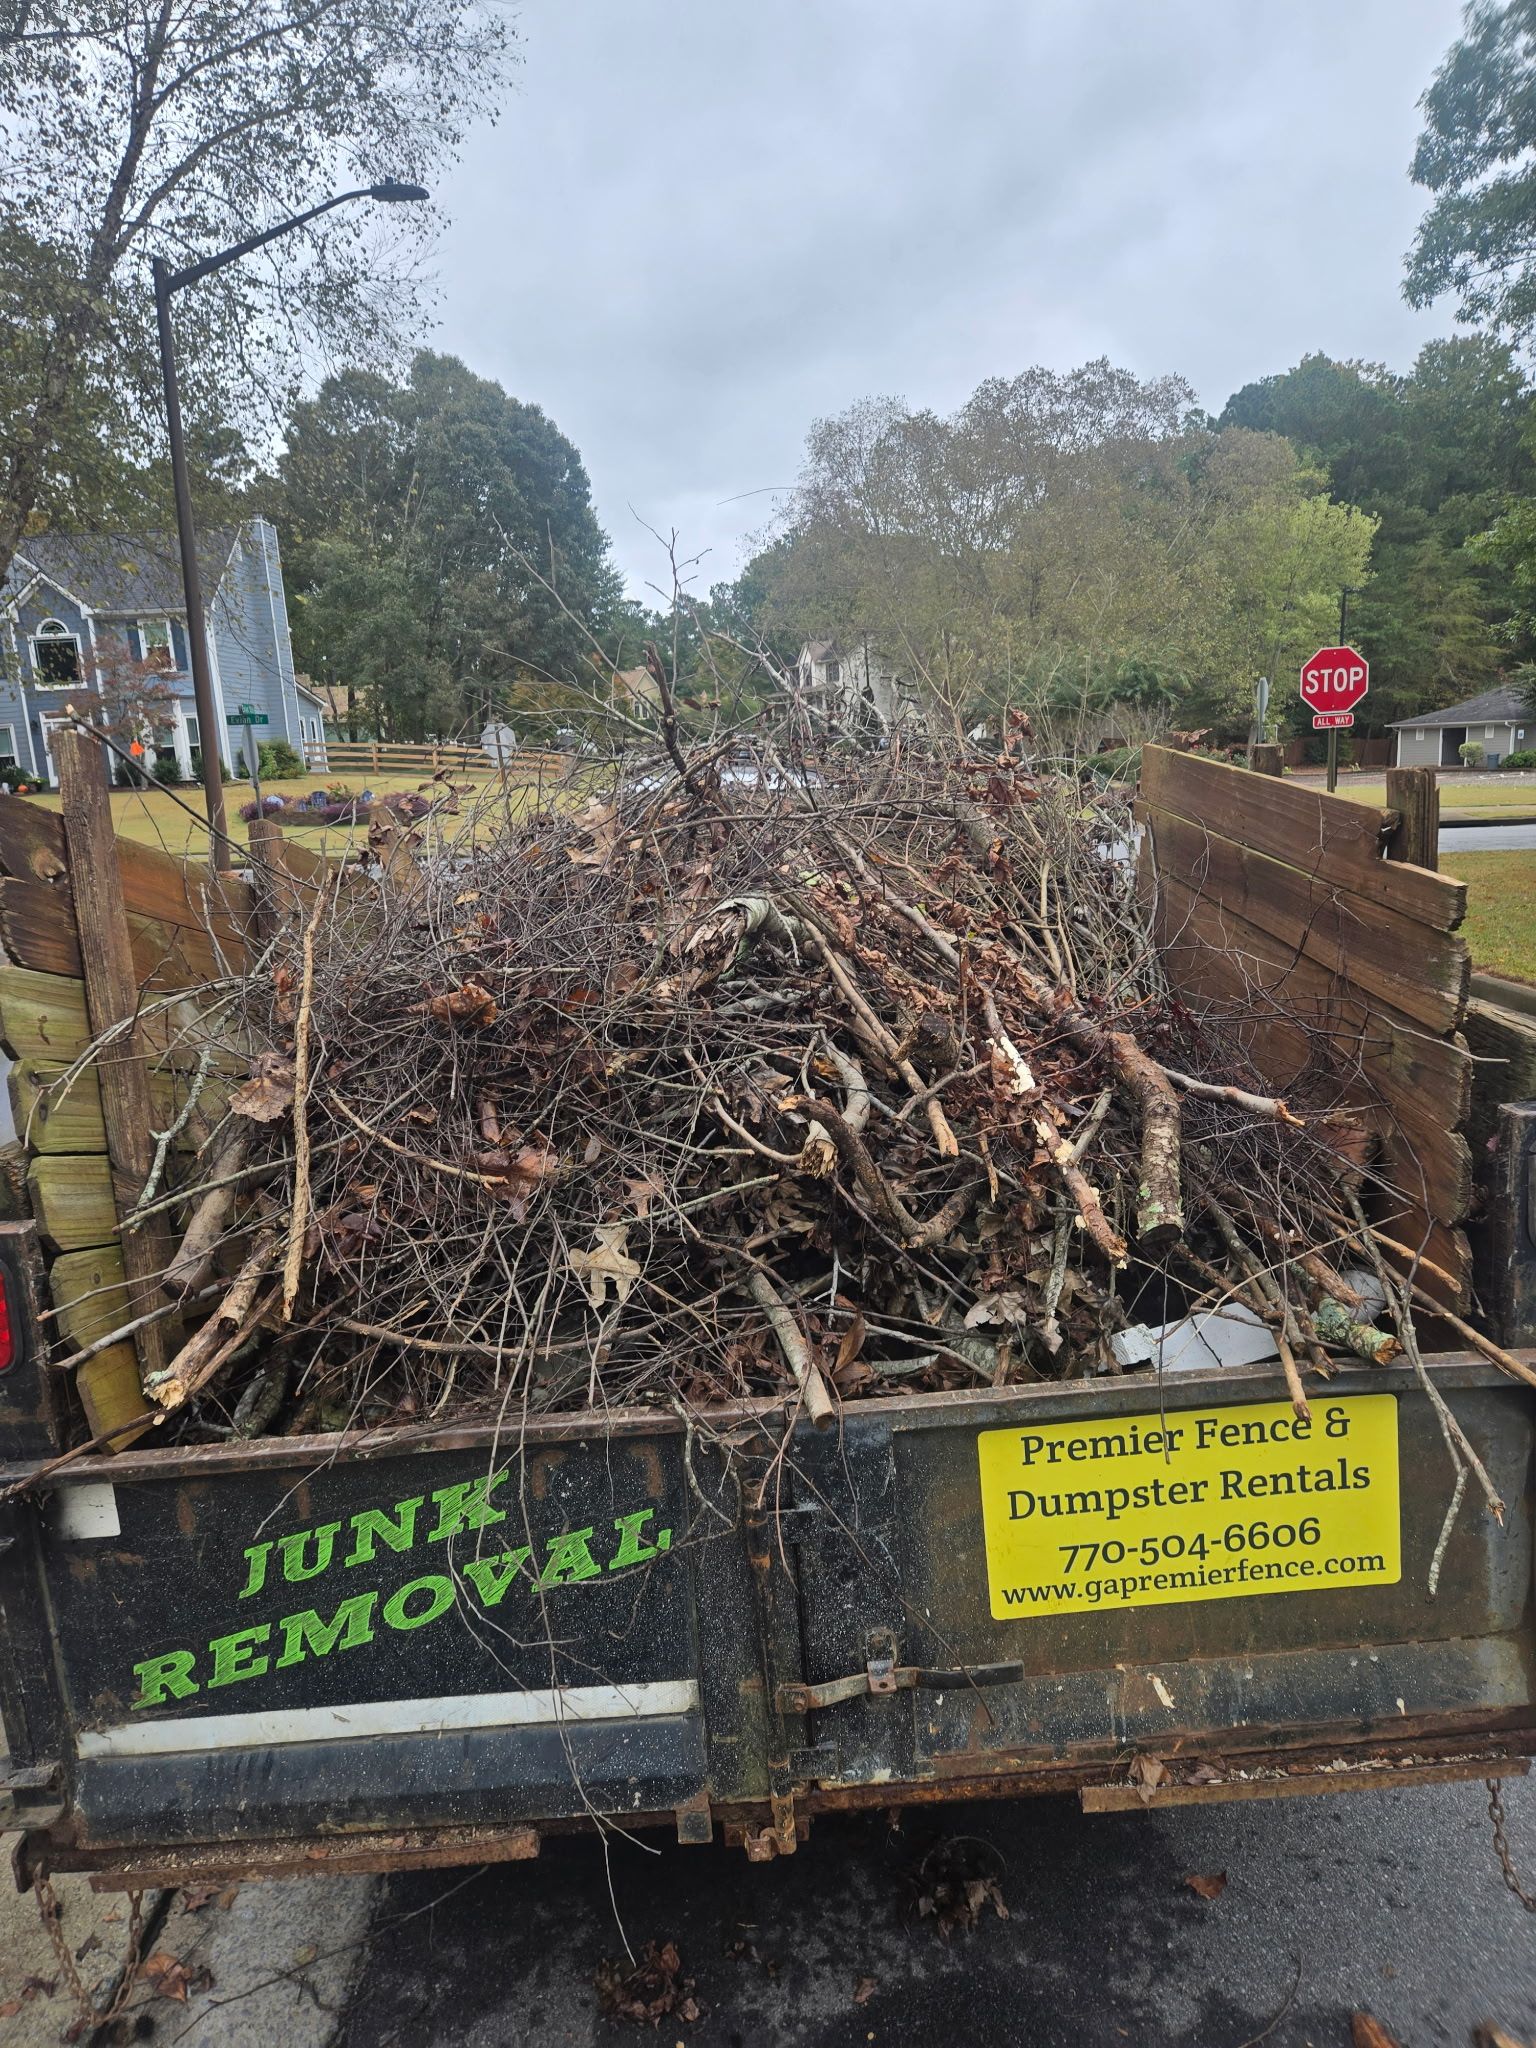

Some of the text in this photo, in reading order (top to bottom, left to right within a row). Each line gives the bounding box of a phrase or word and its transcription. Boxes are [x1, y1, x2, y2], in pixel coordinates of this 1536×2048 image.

[1305, 667, 1364, 694] STOP
[255, 715, 264, 724] Dr
[1316, 716, 1350, 726] ALL WAY
[1020, 1406, 1351, 1466] Premier Fence &
[1007, 1457, 1371, 1521] Dumpster Rentals
[239, 1470, 509, 1599] JUNK
[1058, 1517, 1321, 1574] 770-504-6606
[1001, 1553, 1387, 1605] www.gapremierfence.com
[131, 1508, 672, 1710] REMOVAL
